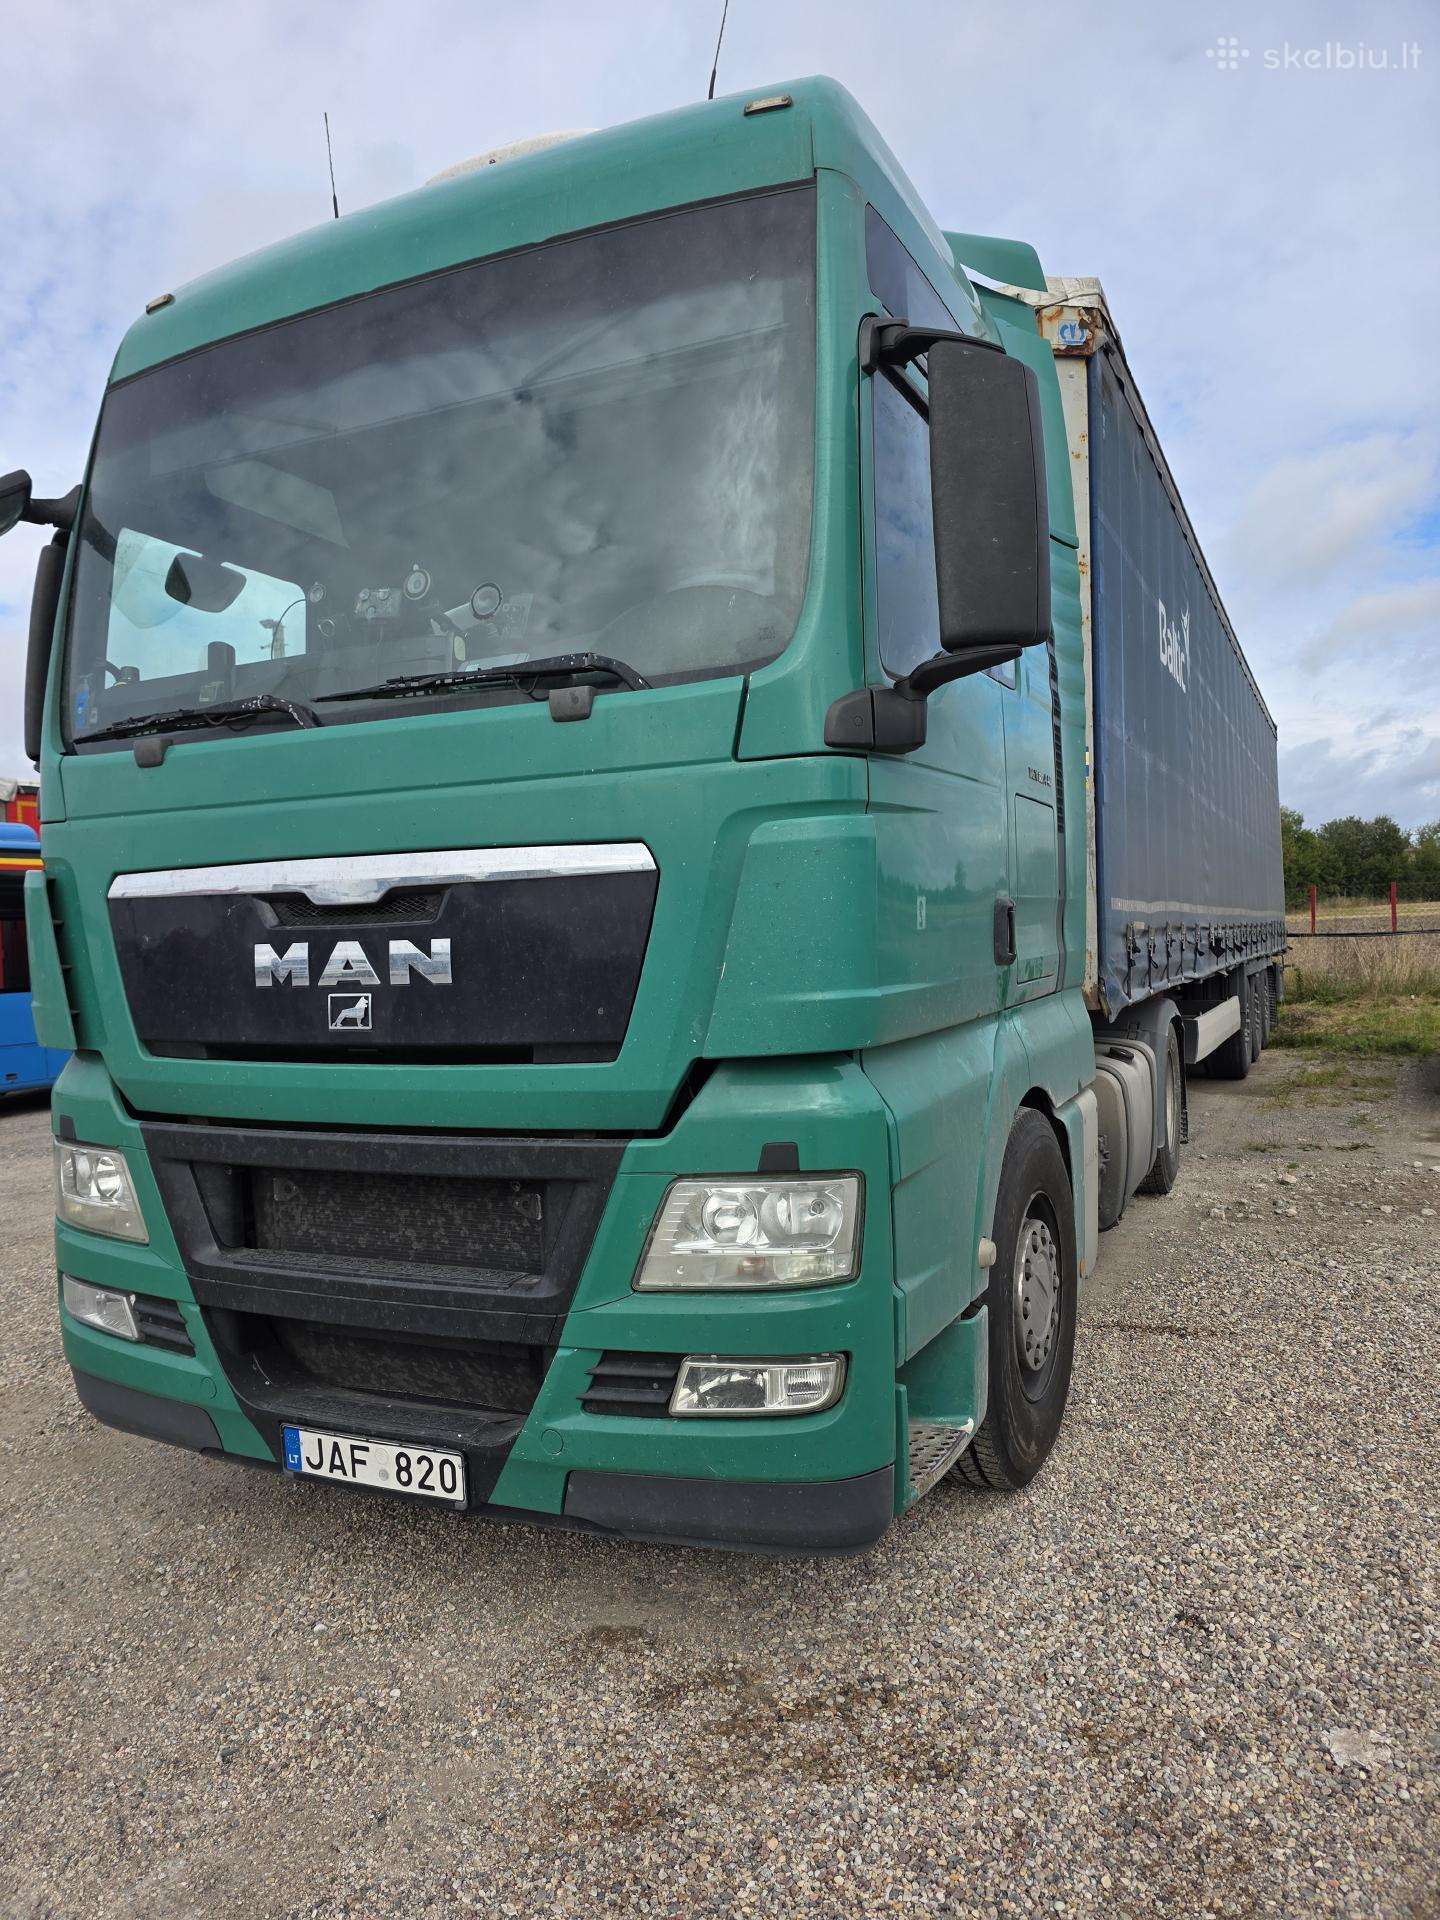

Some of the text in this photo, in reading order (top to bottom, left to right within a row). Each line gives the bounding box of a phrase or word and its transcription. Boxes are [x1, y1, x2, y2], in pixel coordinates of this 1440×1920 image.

[1158, 598, 1187, 694] Baltic
[254, 938, 453, 987] MAN
[289, 1454, 299, 1465] LT
[305, 1438, 457, 1494] JAF 820
